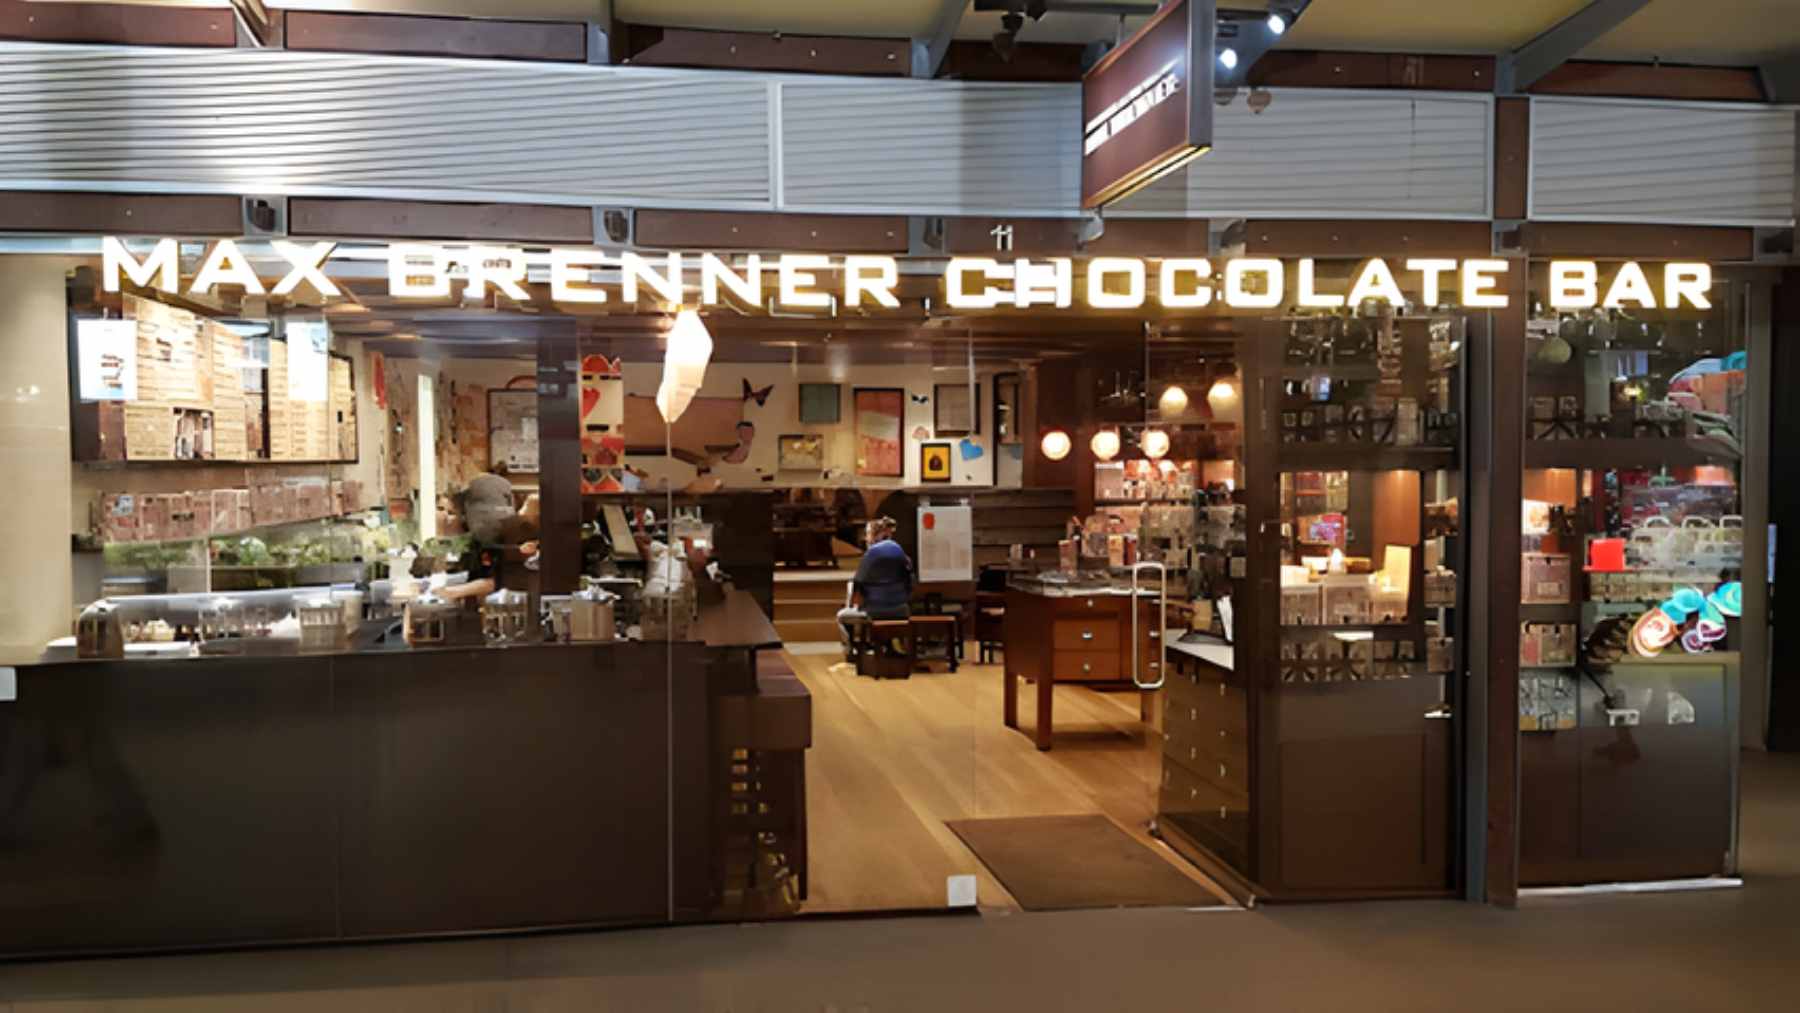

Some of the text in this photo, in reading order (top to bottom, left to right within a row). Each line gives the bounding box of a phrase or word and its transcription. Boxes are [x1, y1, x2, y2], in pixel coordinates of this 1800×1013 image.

[101, 236, 1713, 309] MAX BRENNER CHOCOLATE BAR
